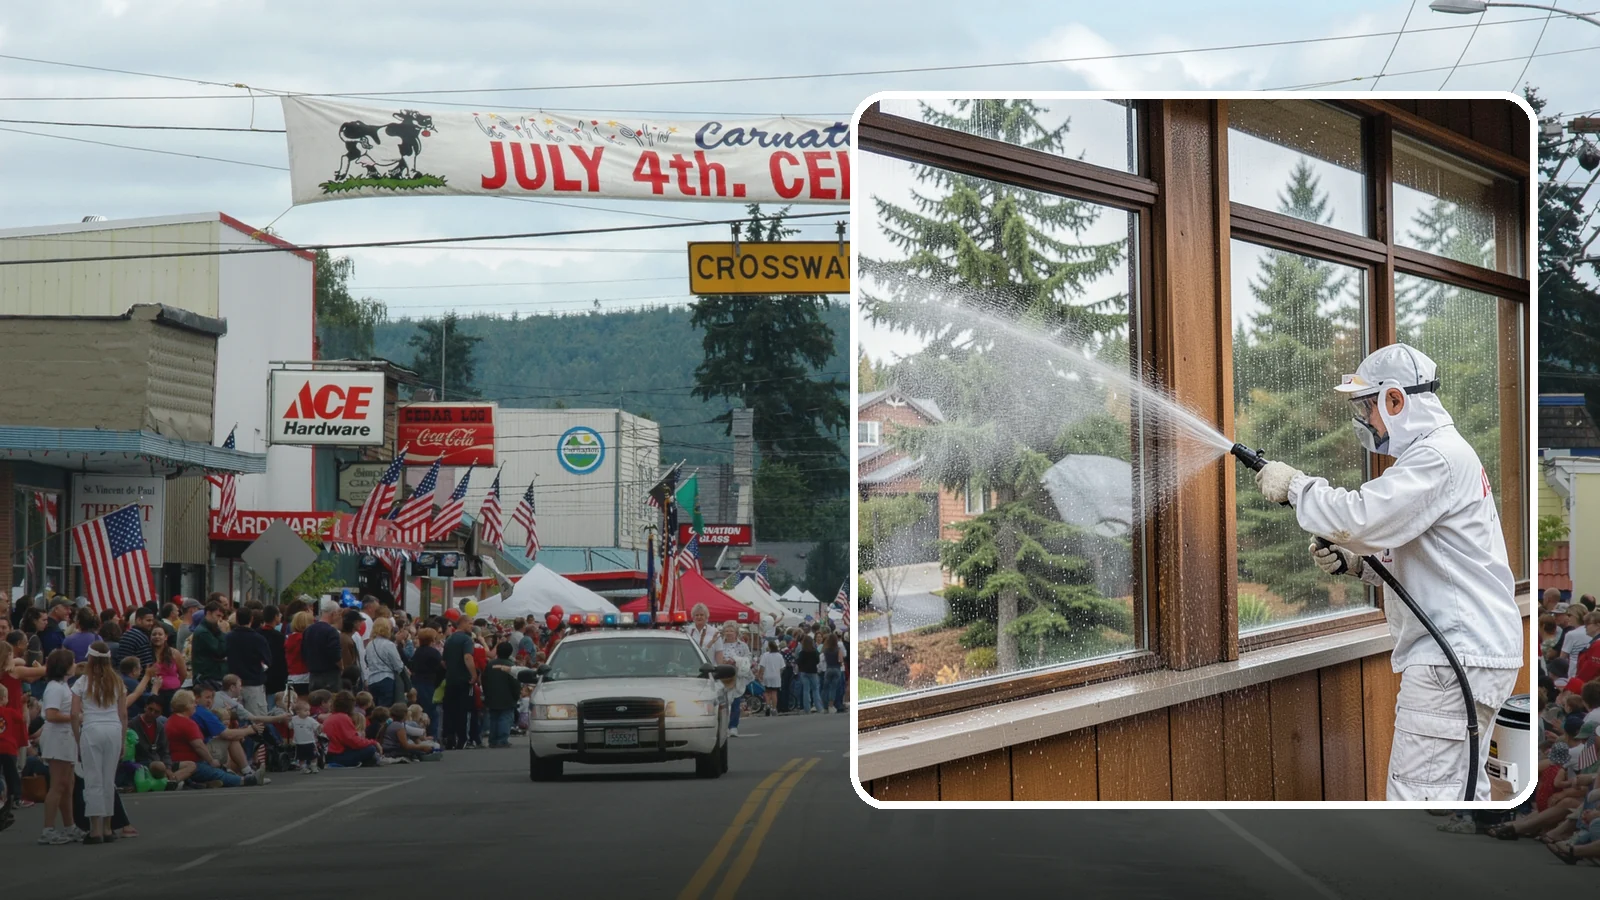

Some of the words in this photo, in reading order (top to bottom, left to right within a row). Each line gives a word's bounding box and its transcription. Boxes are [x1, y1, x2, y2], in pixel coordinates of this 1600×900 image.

[694, 121, 851, 150] Carnat
[480, 140, 605, 193] JULY
[632, 149, 747, 198] 4th.
[696, 253, 851, 280] CROSSWA
[282, 379, 374, 420] ACE
[405, 408, 453, 422] CEDAR
[460, 408, 485, 422] LOG
[283, 420, 371, 437] Hardware
[353, 467, 386, 479] Simpl
[83, 484, 94, 494] St.
[95, 484, 124, 495] Vincent
[126, 485, 136, 495] de
[137, 485, 155, 495] Paul
[687, 526, 742, 535] CRNATION
[699, 535, 730, 543] GLASS
